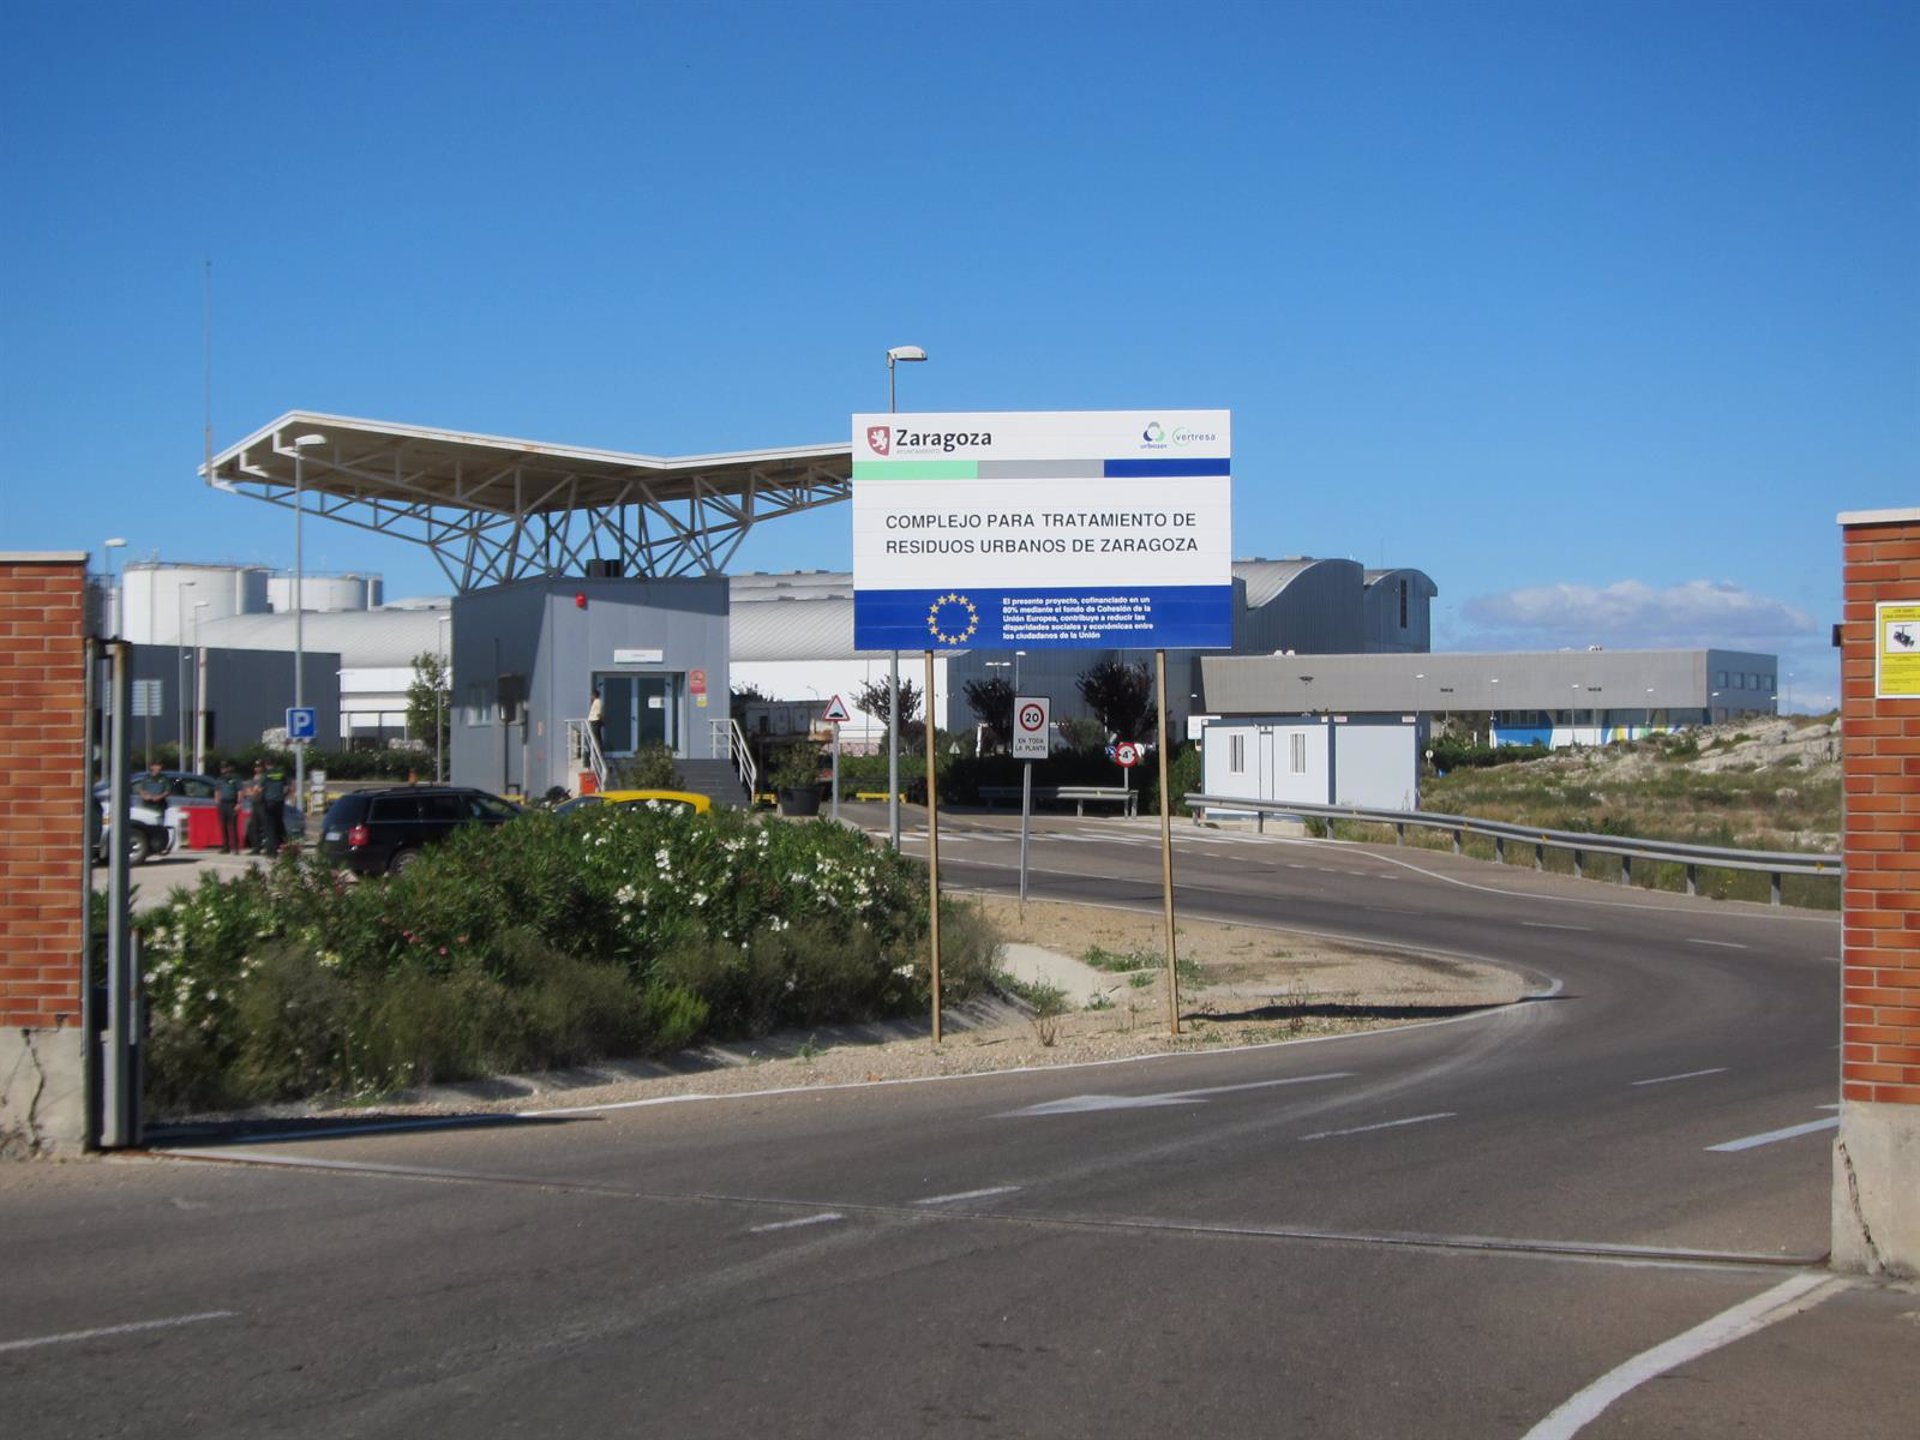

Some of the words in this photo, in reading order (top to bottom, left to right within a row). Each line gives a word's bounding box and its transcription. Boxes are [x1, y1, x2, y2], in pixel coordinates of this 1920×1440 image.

[896, 429, 992, 452] Zaragoza
[886, 514, 981, 529] COMPLEJO
[987, 513, 1034, 528] PARA
[1042, 512, 1168, 528] TRATAMIENTO
[1173, 512, 1196, 527] DE
[886, 539, 974, 554] RESIDUOS
[980, 539, 1066, 553] URBANOS
[1073, 538, 1095, 553] DE
[1101, 537, 1198, 552] ZARAGOZA
[1012, 598, 1043, 606] presente
[1045, 598, 1079, 606] proyecto,
[1003, 624, 1049, 632] disparidades
[293, 712, 311, 735] P
[1025, 713, 1039, 722] 20
